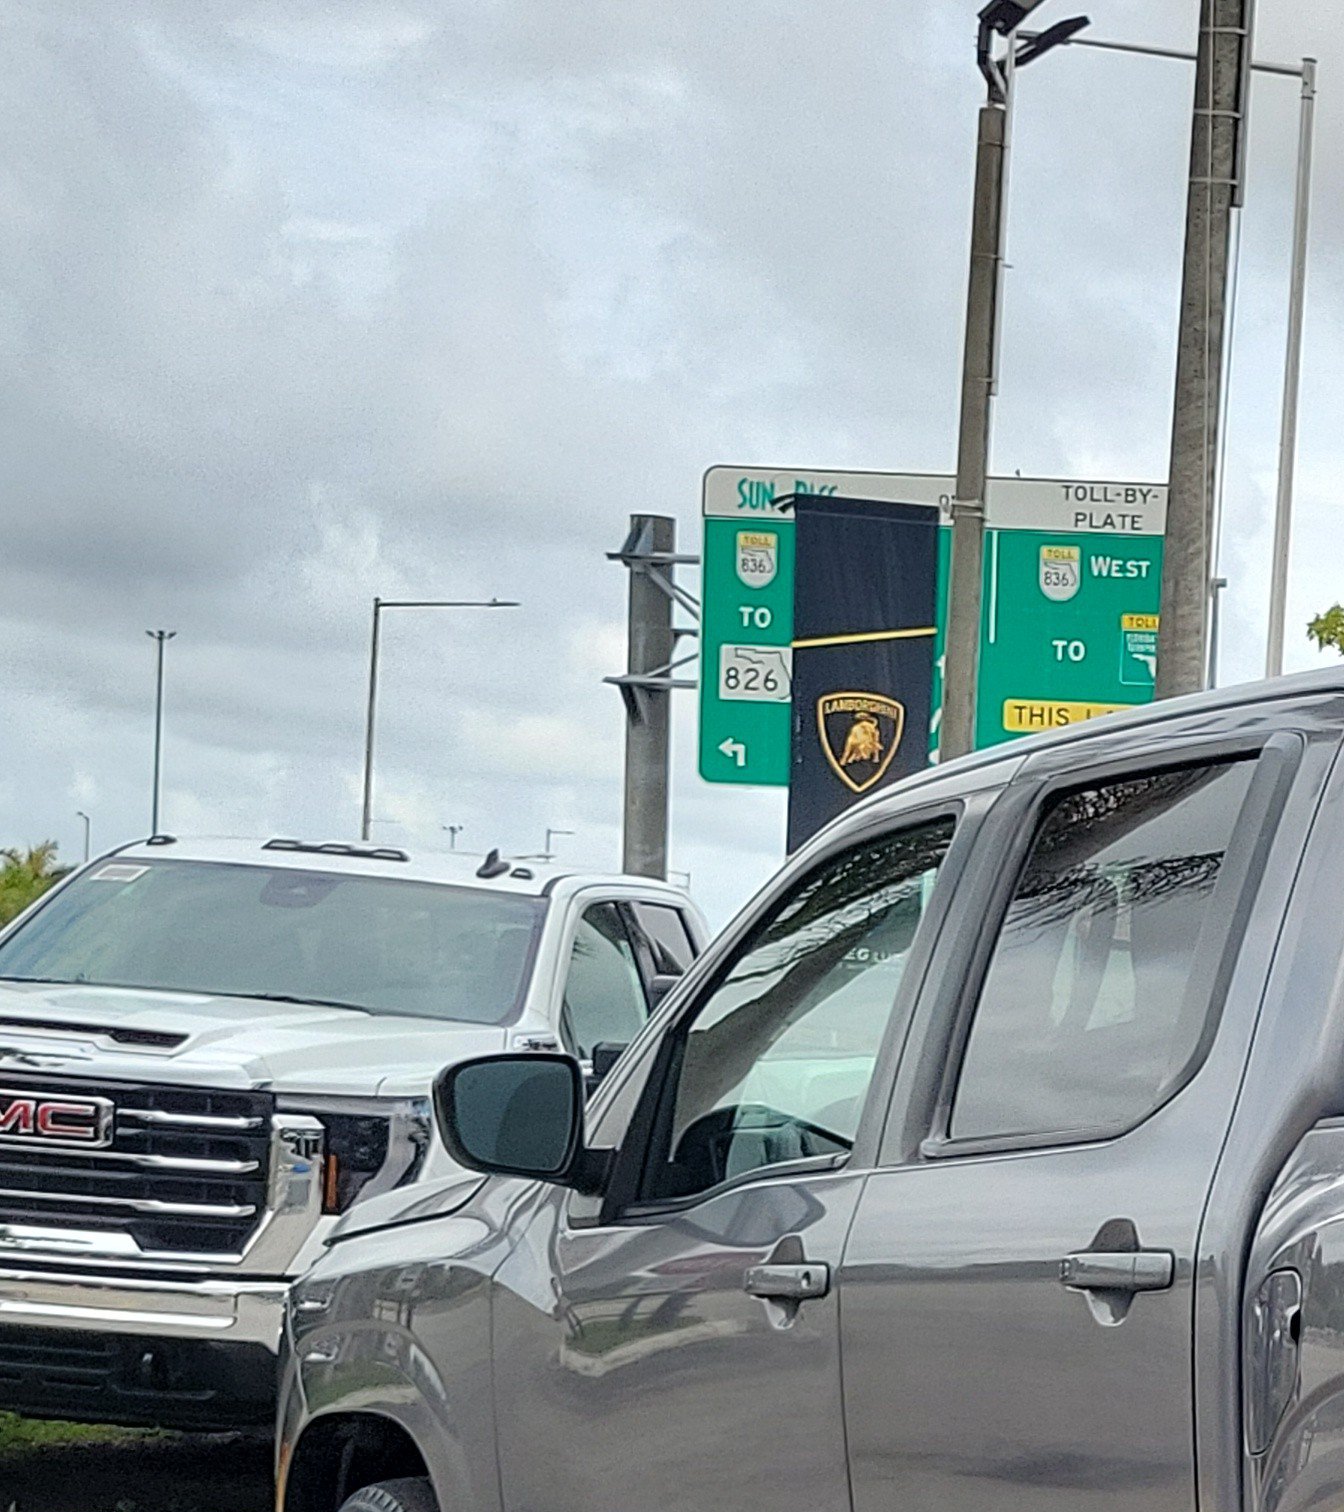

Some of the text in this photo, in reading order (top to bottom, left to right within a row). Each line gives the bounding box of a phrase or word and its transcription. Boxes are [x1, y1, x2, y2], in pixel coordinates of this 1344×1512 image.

[1061, 484, 1159, 504] TOLL-BY-
[1074, 512, 1143, 531] PLATE
[743, 535, 772, 546] TOLL
[1046, 548, 1076, 560] TOLL
[741, 558, 766, 573] 836
[1043, 571, 1069, 586] 836
[738, 606, 772, 629] TO
[1051, 639, 1086, 662] TO
[725, 666, 779, 692] 826
[1013, 705, 1070, 727] THIS
[0, 1099, 96, 1138] MC
